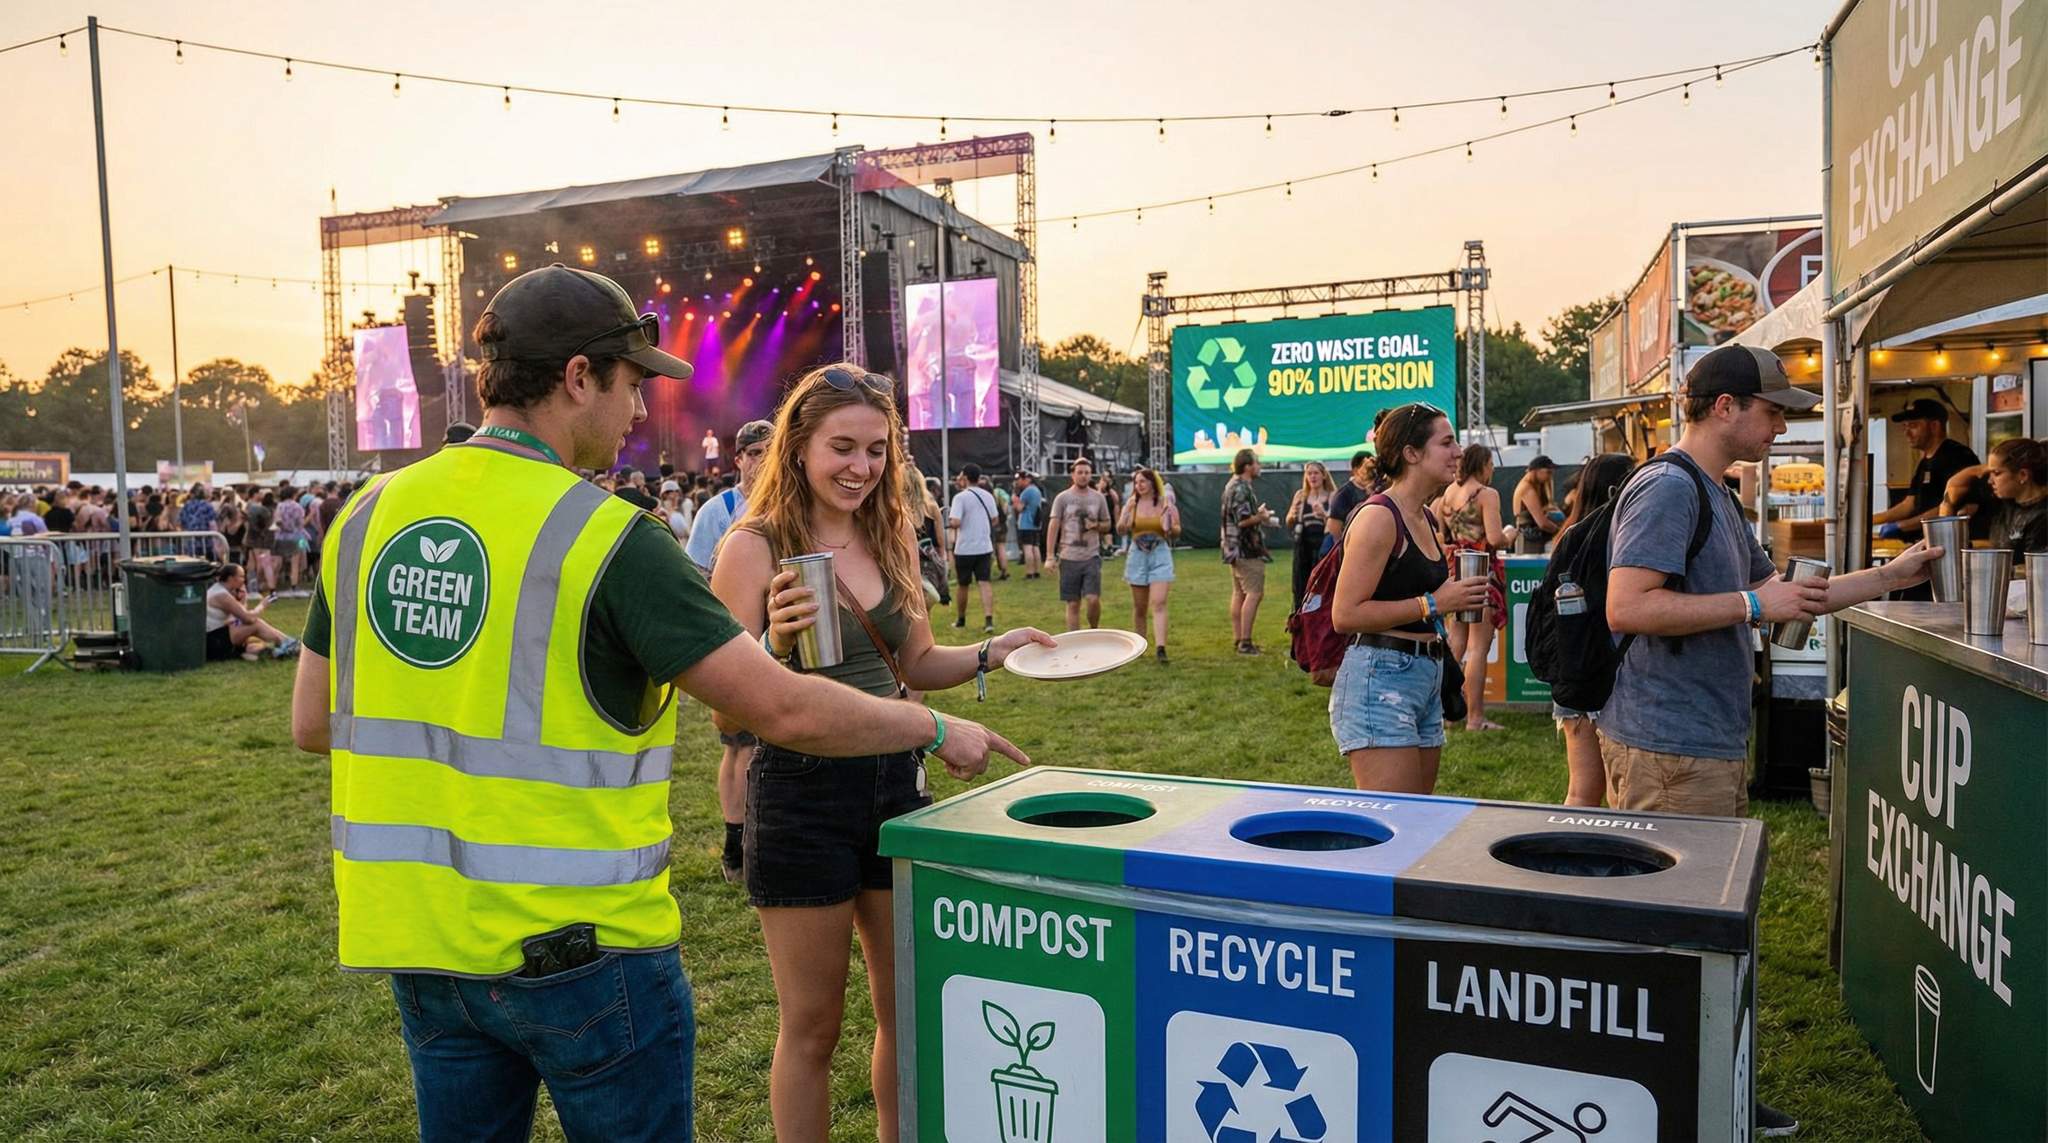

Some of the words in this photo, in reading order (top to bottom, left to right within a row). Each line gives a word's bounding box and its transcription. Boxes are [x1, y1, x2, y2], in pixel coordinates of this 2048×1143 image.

[1848, 0, 2024, 249] EXCHANGE
[1271, 341, 1314, 364] ZERO
[1317, 337, 1375, 362] WASTE
[1378, 334, 1429, 358] GOAL:
[1268, 367, 1314, 396] 90%
[1319, 360, 1433, 394] DIVERSION
[387, 563, 473, 607] GREEN
[391, 600, 463, 641] TEAM
[1901, 684, 1972, 829] CUP
[1088, 779, 1180, 793] COMPOST
[1303, 797, 1399, 810] RECYCLE
[1547, 815, 1659, 832] LANDFILL
[1867, 788, 2015, 1007] EXCHANGE
[933, 896, 1112, 962] COMPOST
[1169, 927, 1356, 998] RECYCLE
[1427, 960, 1665, 1042] LANDFILL
